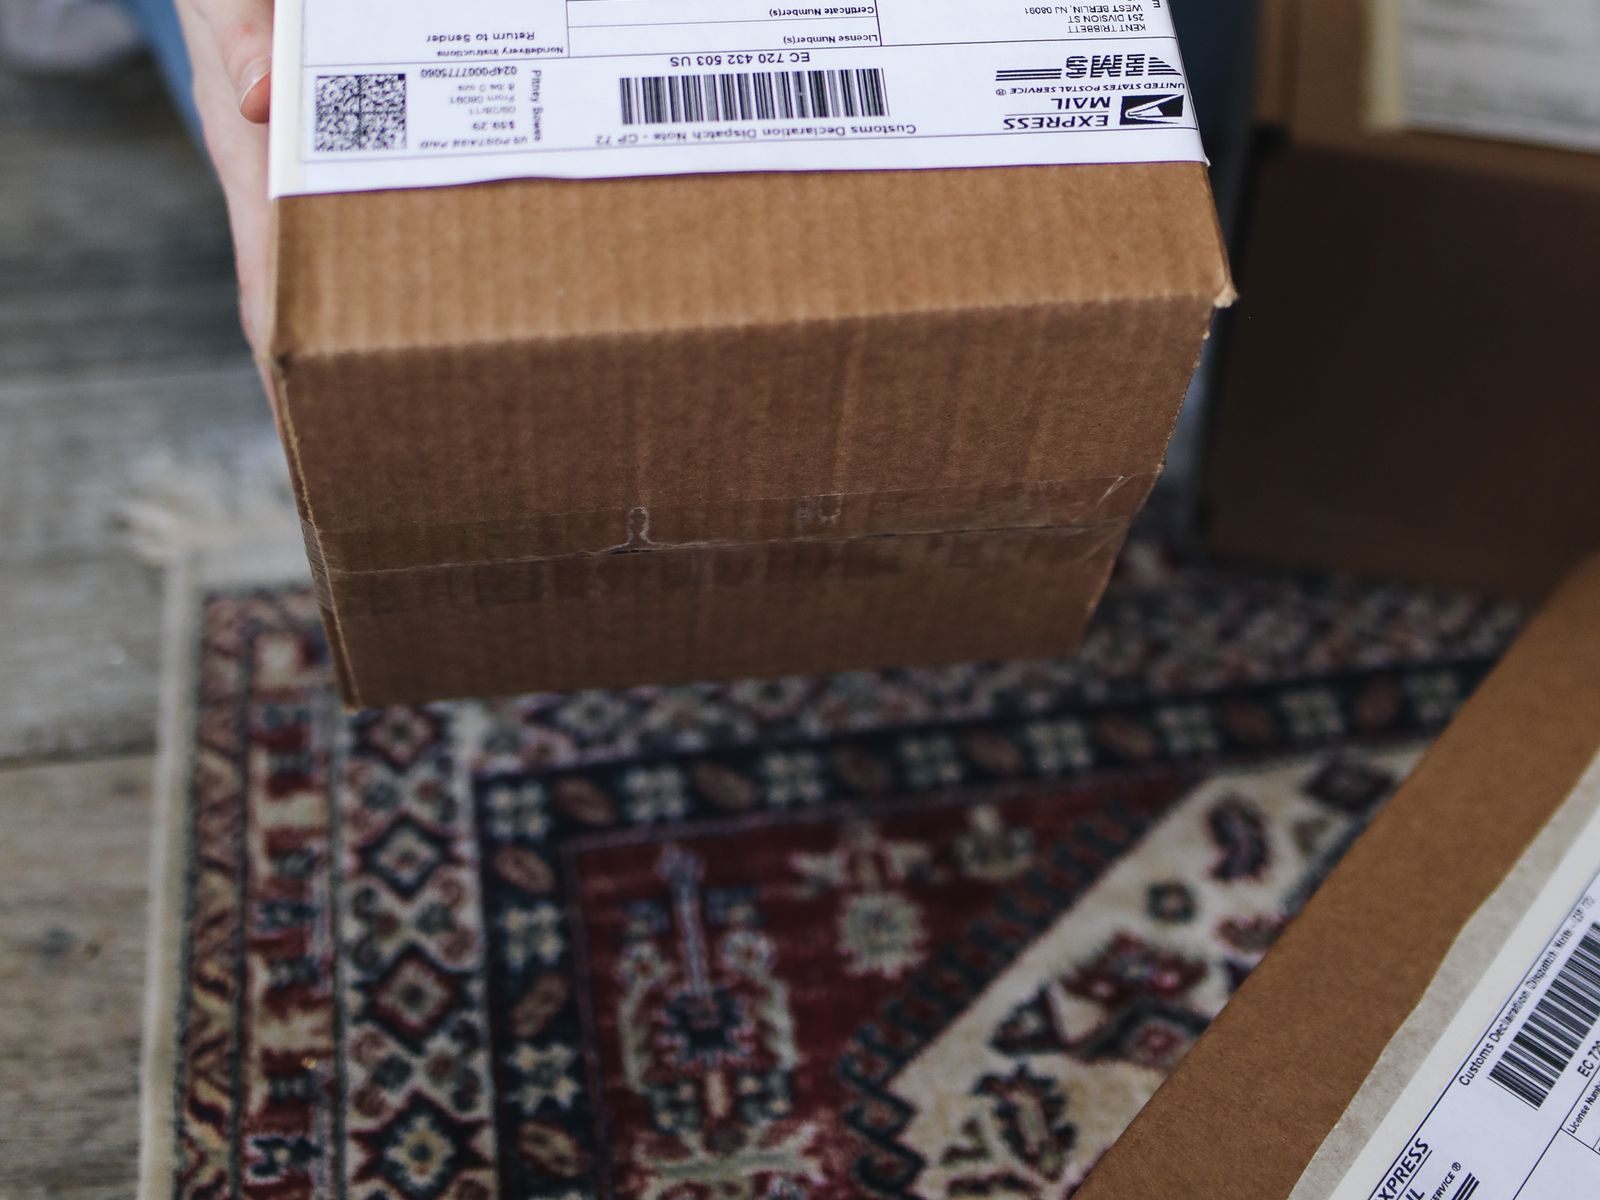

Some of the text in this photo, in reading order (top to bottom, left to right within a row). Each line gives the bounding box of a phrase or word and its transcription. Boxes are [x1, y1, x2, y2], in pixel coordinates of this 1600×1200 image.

[768, 6, 874, 18] Certificate Number(s)
[1024, 4, 1143, 15] WEST BERLIN, NJ 08091
[1067, 15, 1081, 24] ST
[1127, 13, 1145, 22] 251
[1067, 23, 1146, 34] KENT TRIBBETT
[426, 31, 535, 44] Return to Sender
[782, 34, 878, 45] License Number(s)
[437, 45, 564, 57] Nondelivery Instructions
[669, 51, 810, 68] EC 720 432 503 US
[1066, 54, 1145, 78] EMS
[529, 70, 542, 102] Pitney
[1010, 82, 1185, 94] UNITED STATES POSTAL SERVICE
[1050, 96, 1111, 109] MAIL
[1002, 115, 1109, 130] EXPRESS
[595, 124, 917, 146] Customs Declaration Dispatch Note CP 72
[420, 141, 448, 149] PAID
[1459, 990, 1529, 1086] Customs Declaration
[1577, 1060, 1594, 1078] EC
[1567, 1105, 1590, 1134] License
[1374, 1138, 1428, 1200] XPRESS
